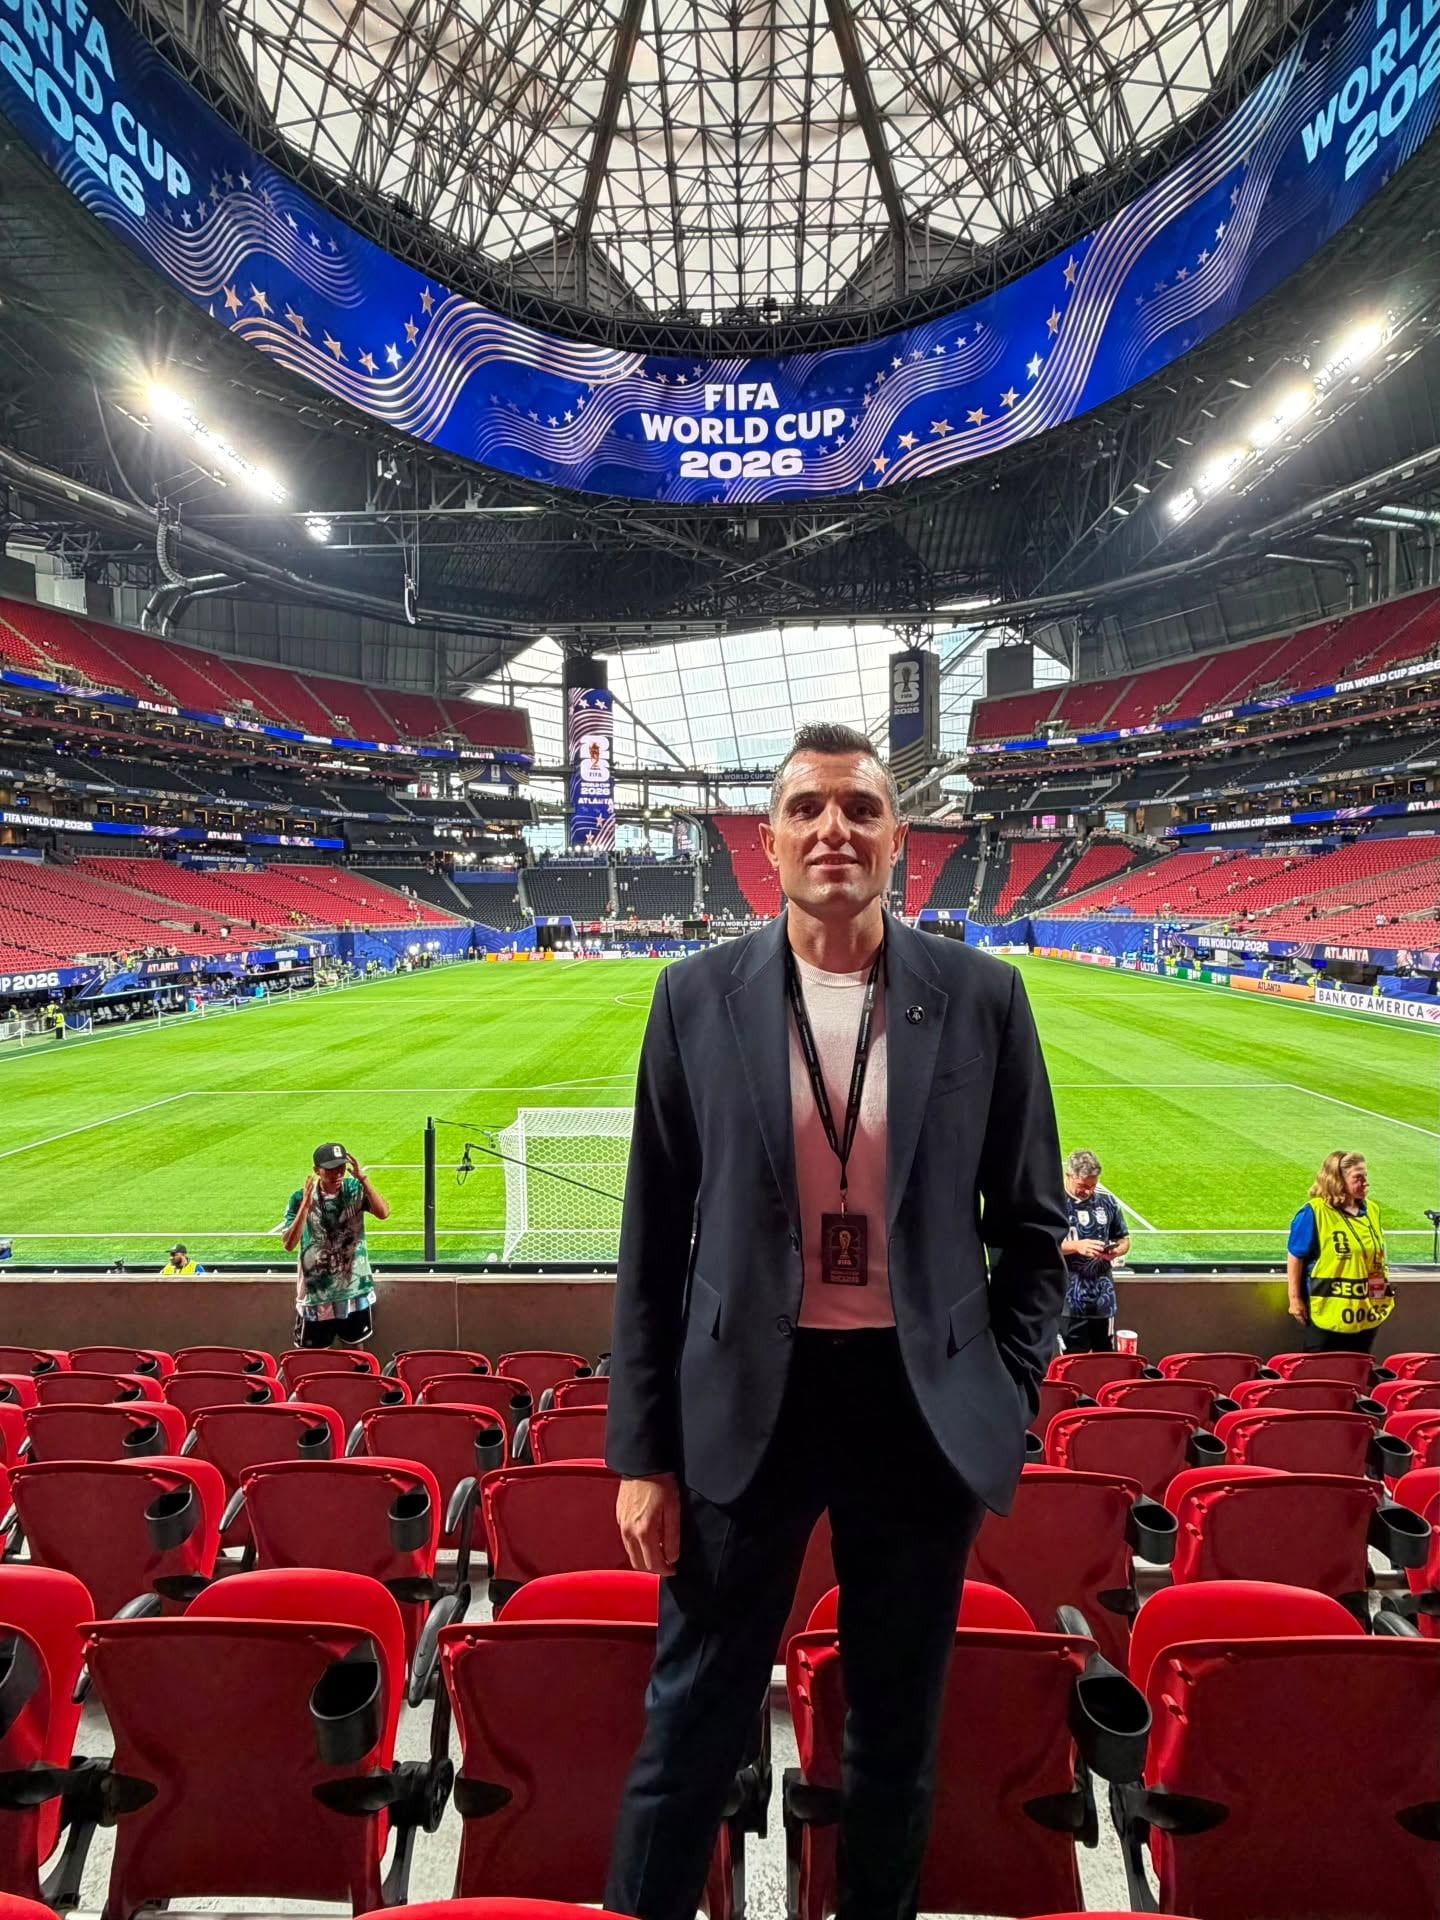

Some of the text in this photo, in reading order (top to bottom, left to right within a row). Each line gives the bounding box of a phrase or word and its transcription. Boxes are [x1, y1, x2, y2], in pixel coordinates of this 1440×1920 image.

[0, 17, 146, 217] 2026
[111, 101, 191, 199] CUP
[704, 382, 780, 411] FIFA
[640, 408, 845, 444] WORLD CUP
[679, 447, 804, 479] 2026
[1335, 681, 1354, 694] FIFA
[1354, 673, 1388, 689] WORLD
[1388, 668, 1407, 681] CUP
[137, 700, 179, 716] ATLANTA
[1202, 710, 1233, 724] ATLANTA
[460, 751, 494, 759] ATLANTA
[1264, 779, 1299, 790] ATLANTA
[215, 798, 249, 807] ATLANTA
[3, 812, 21, 823] FIFA
[21, 813, 49, 827] WORLD
[49, 818, 64, 828] CUP
[1211, 821, 1226, 831] FIFA
[1226, 819, 1250, 830] WORLD
[1250, 817, 1264, 827] CUP
[207, 831, 242, 841] ATLANTA
[1198, 936, 1269, 953] FIFA WORLD CUP 2026
[658, 950, 687, 958] ULTRA
[1324, 946, 1369, 962] ATLANTA
[147, 961, 179, 974] ATLANTA
[13, 972, 59, 991] 2026
[1258, 982, 1281, 993] ATLANTA
[1319, 990, 1424, 1018] BANK OF AMERICA
